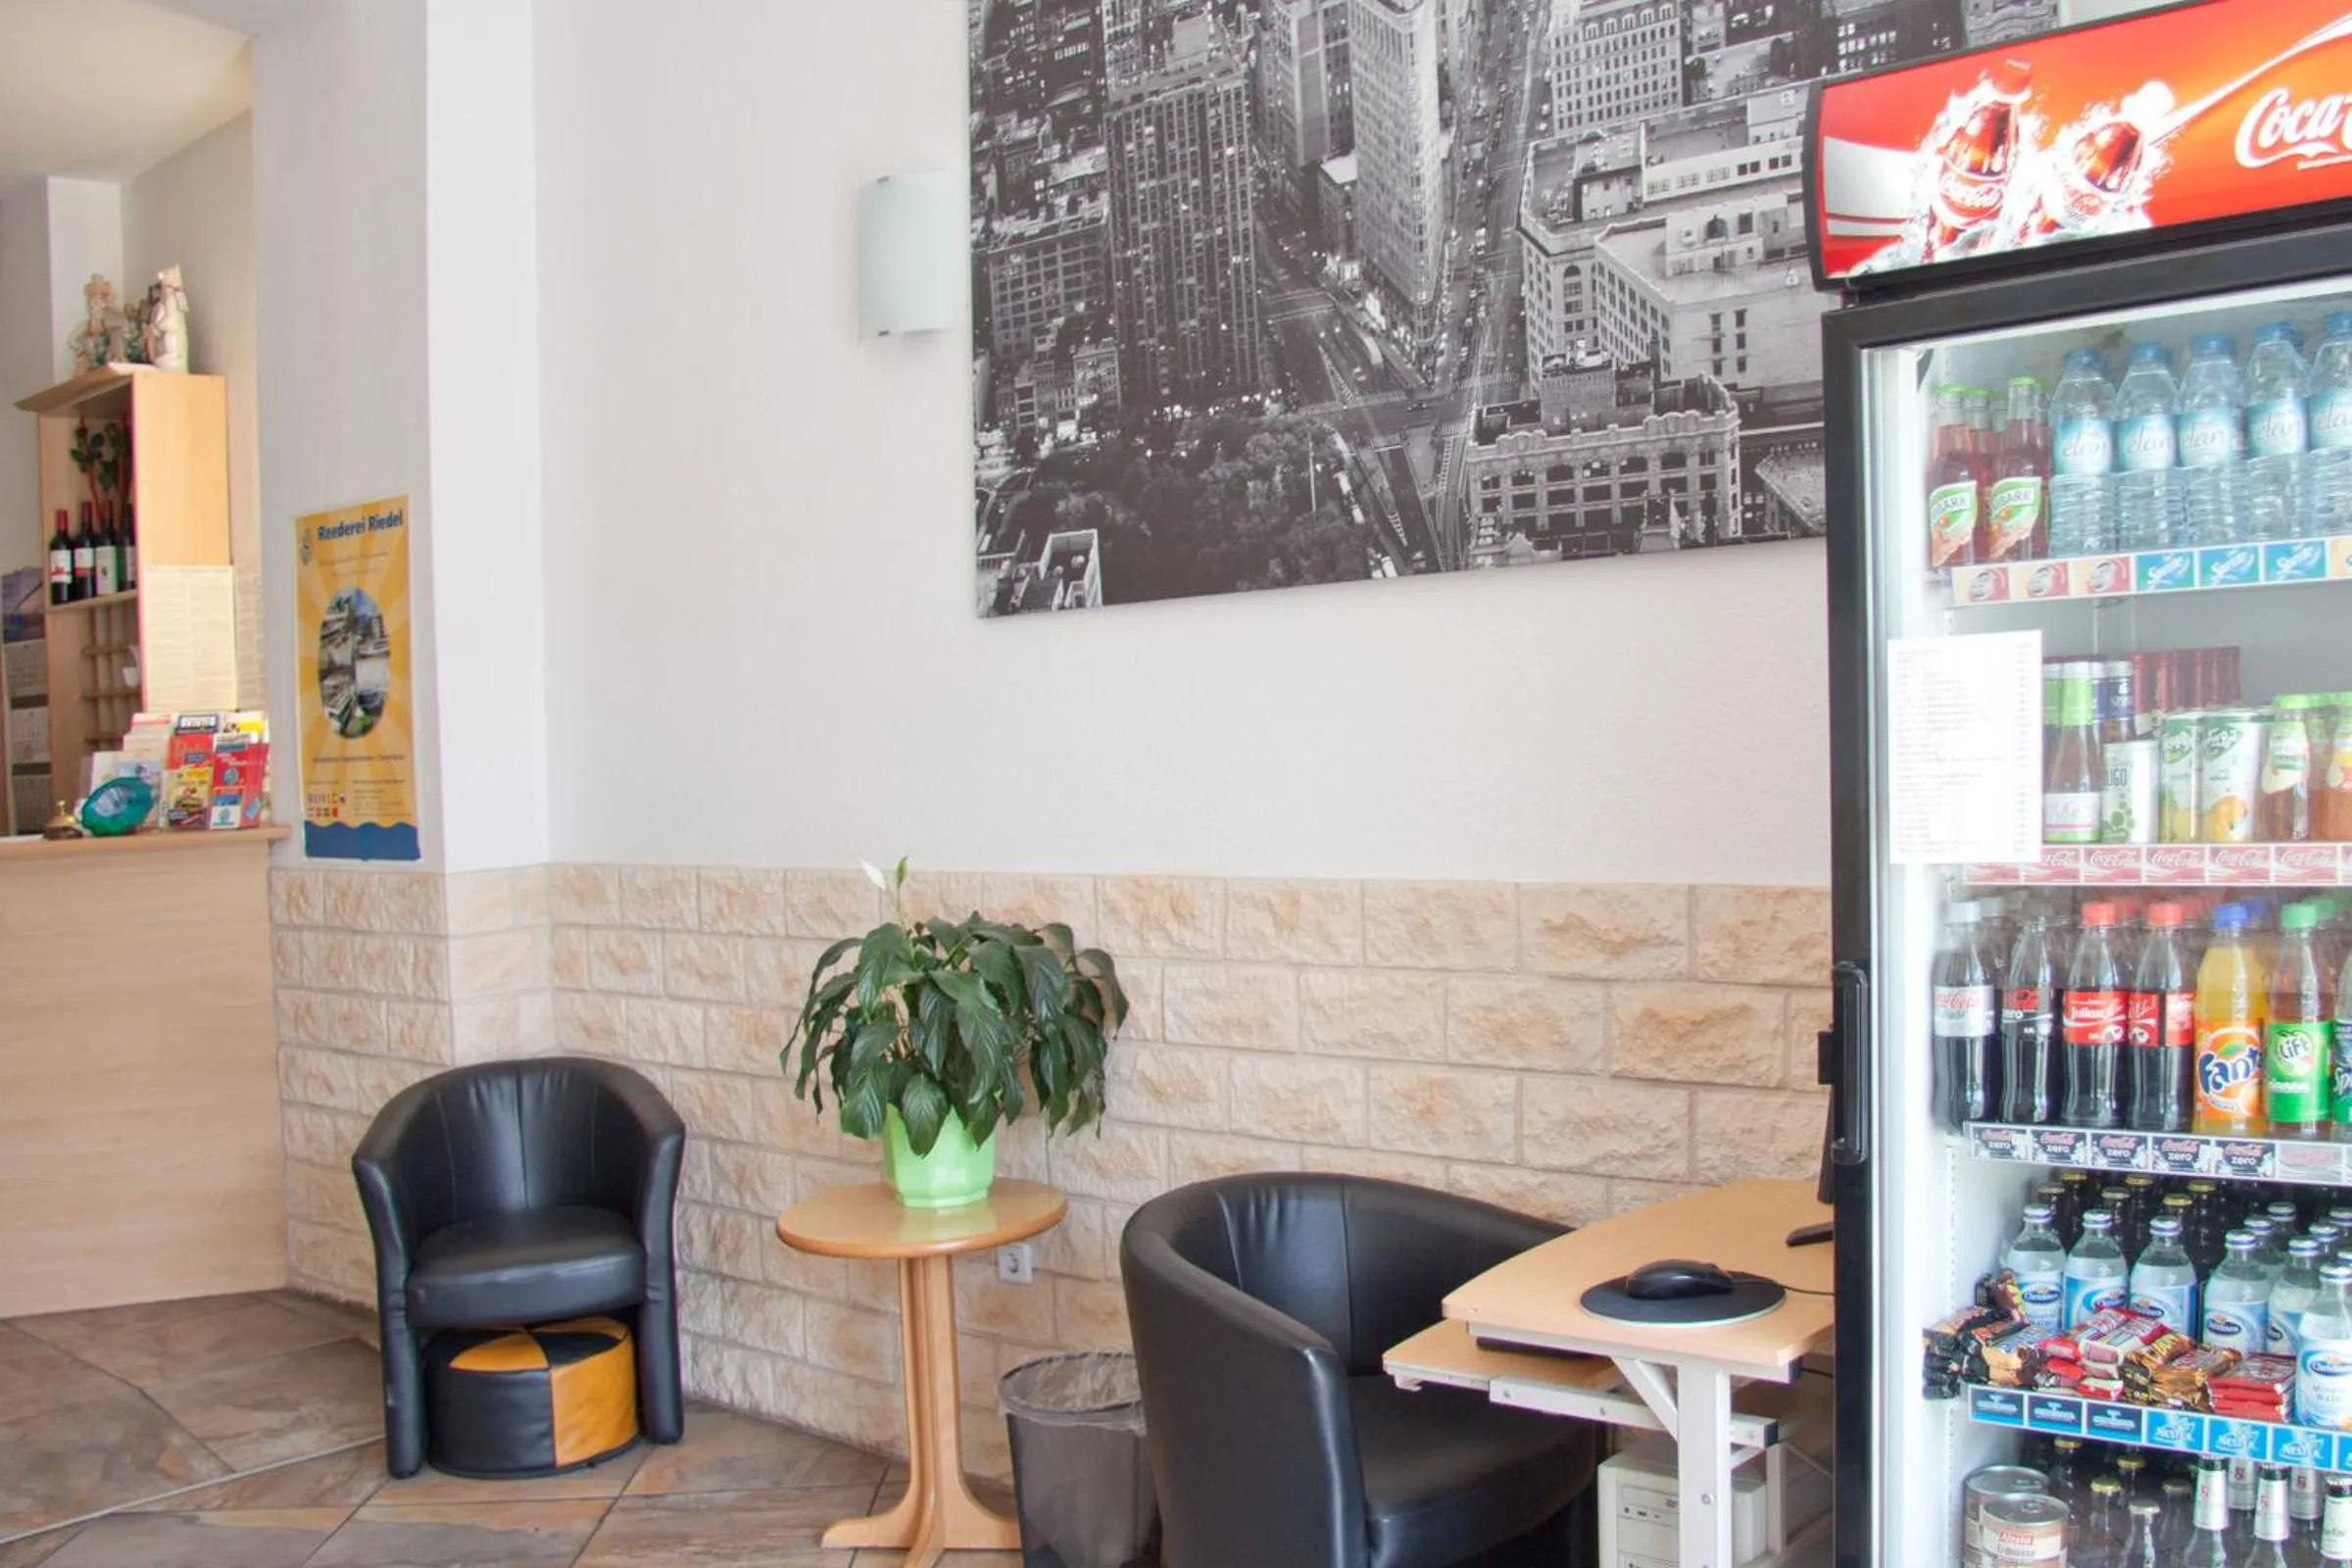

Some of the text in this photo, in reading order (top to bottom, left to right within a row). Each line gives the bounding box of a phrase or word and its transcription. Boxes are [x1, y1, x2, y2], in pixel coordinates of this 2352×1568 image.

[2234, 86, 2352, 170] Coca
[368, 509, 404, 530] Riedel
[2198, 1046, 2265, 1094] Fant
